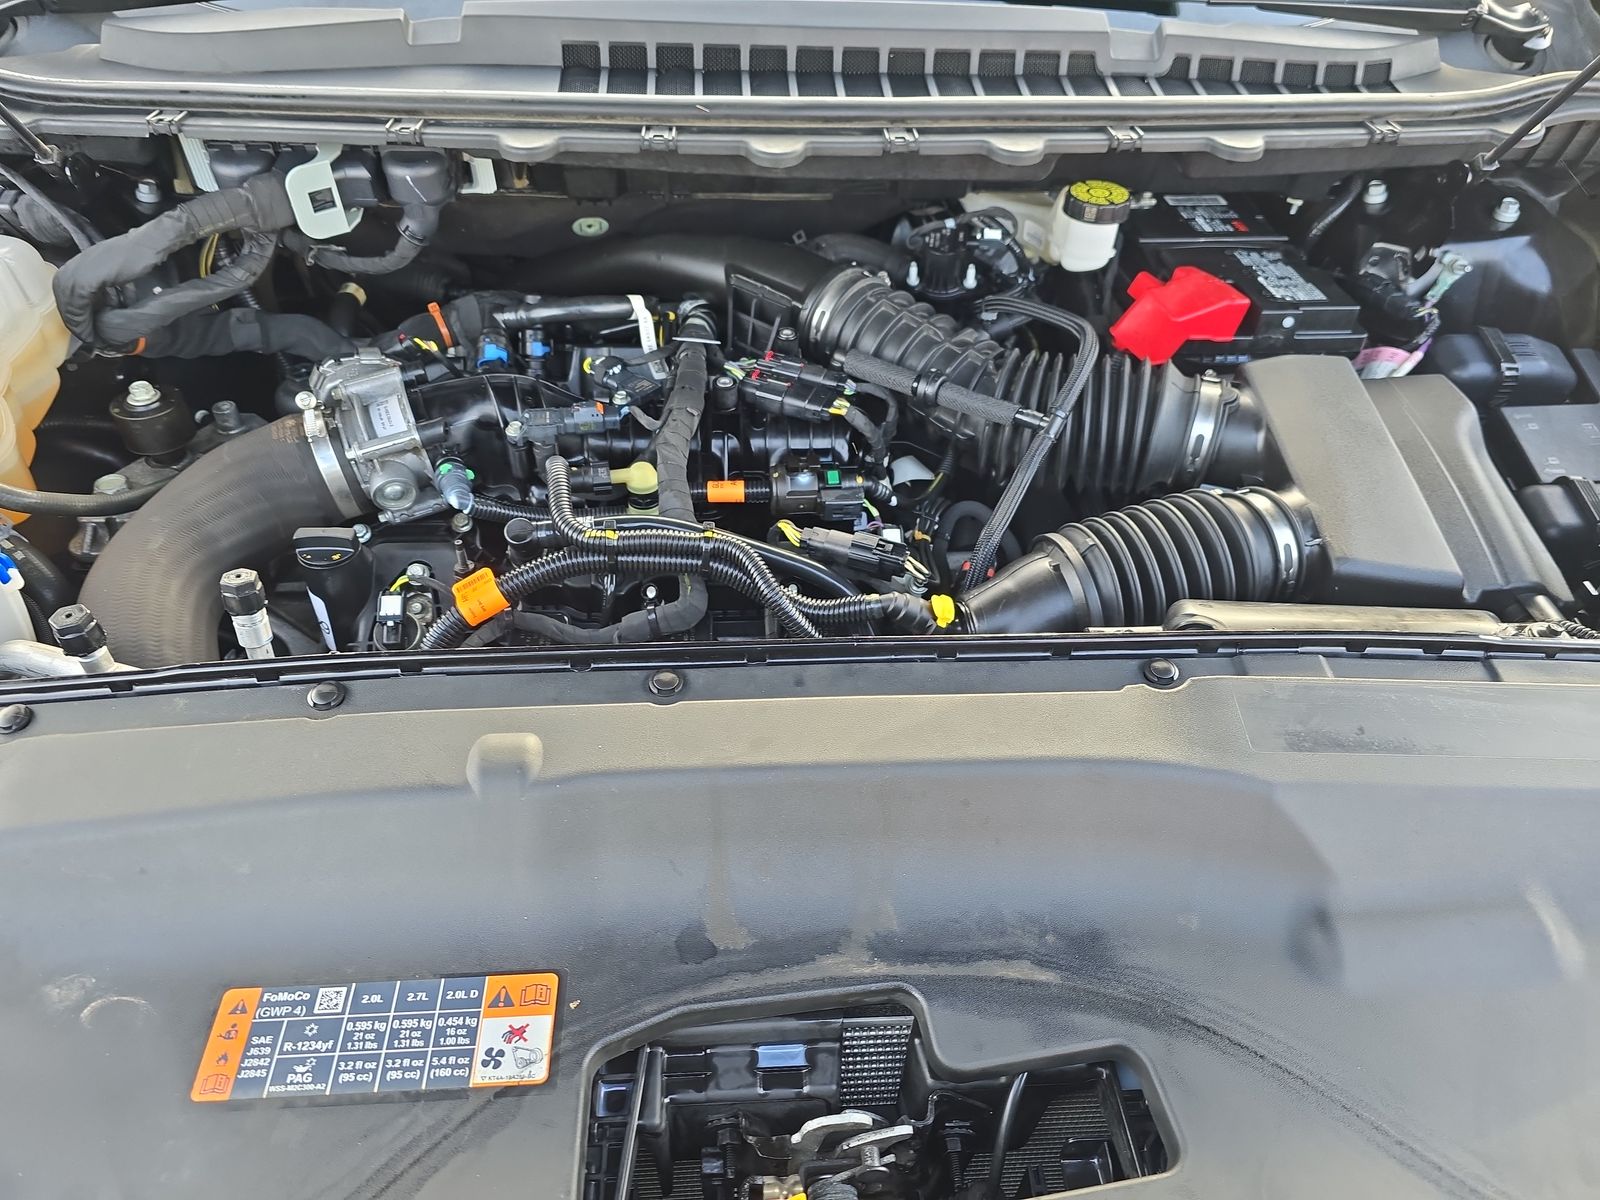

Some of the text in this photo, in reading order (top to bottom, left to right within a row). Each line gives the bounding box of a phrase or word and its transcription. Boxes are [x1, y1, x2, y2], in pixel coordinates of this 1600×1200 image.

[262, 991, 311, 1002] FoMoCo
[361, 994, 384, 1004] 2.0L
[406, 992, 429, 1001] 2.7L
[445, 989, 479, 1000] 2.0L D
[255, 1005, 306, 1019] (GWP 4)
[346, 1020, 387, 1032] 0.595 kg
[392, 1018, 433, 1030] 0.595 kg
[438, 1016, 478, 1027] 0.454 kg
[353, 1032, 376, 1040] 21 oz
[399, 1030, 409, 1038] 21
[446, 1028, 456, 1036] 16
[250, 1035, 274, 1044] SAE
[393, 1039, 425, 1048] 1.31 lbs
[439, 1037, 471, 1045] 1.00 lbs
[283, 1040, 334, 1052] R-1234yf
[347, 1041, 378, 1050] 1.31 lbs
[246, 1047, 271, 1056] J639
[337, 1060, 378, 1071] 3.2 fl oz
[385, 1058, 425, 1068] 3.2 fl oz
[431, 1055, 471, 1066] 5.4 fl oz
[285, 1073, 313, 1083] PAG
[338, 1072, 373, 1084] (95 cc)
[386, 1070, 421, 1082] (95 cc)
[430, 1067, 470, 1079] (160 cc)
